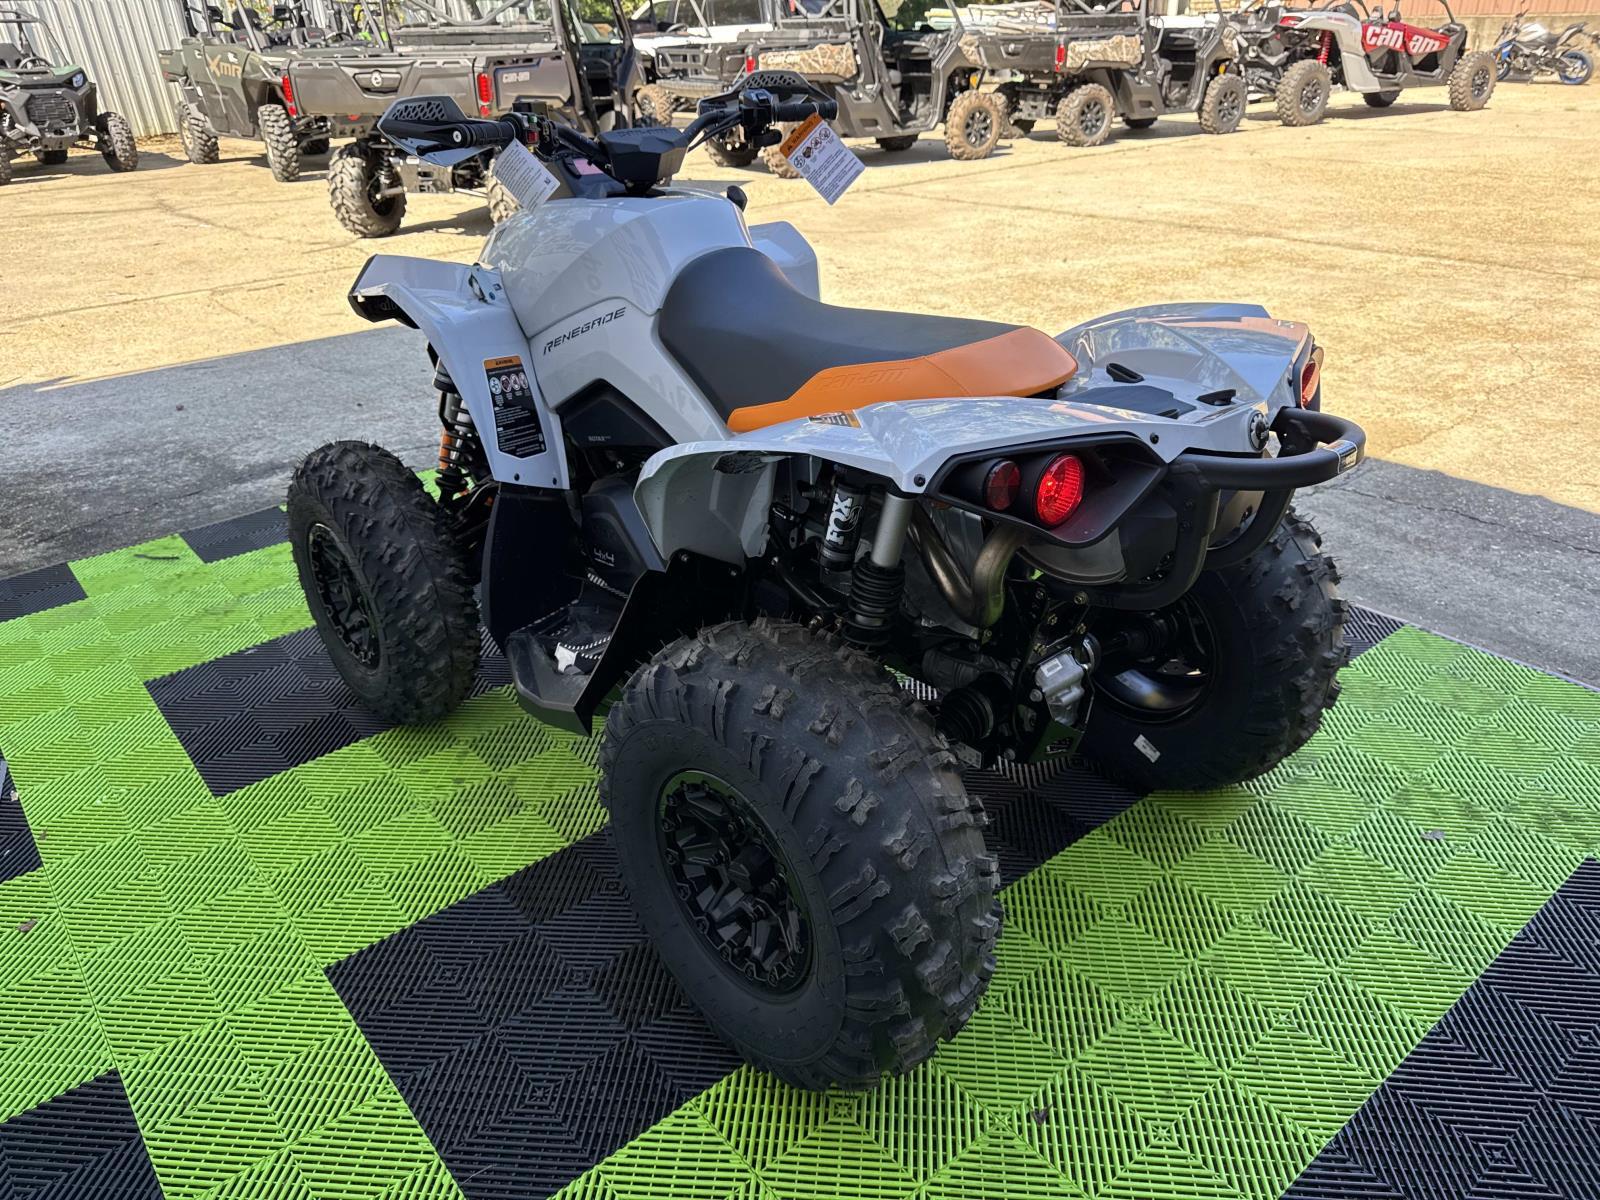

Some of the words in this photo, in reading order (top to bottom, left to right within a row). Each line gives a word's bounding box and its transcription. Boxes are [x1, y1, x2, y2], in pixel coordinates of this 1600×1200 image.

[1366, 26, 1404, 49] can
[1409, 34, 1440, 53] am
[543, 306, 626, 356] RENEGADE
[825, 492, 856, 546] FOX
